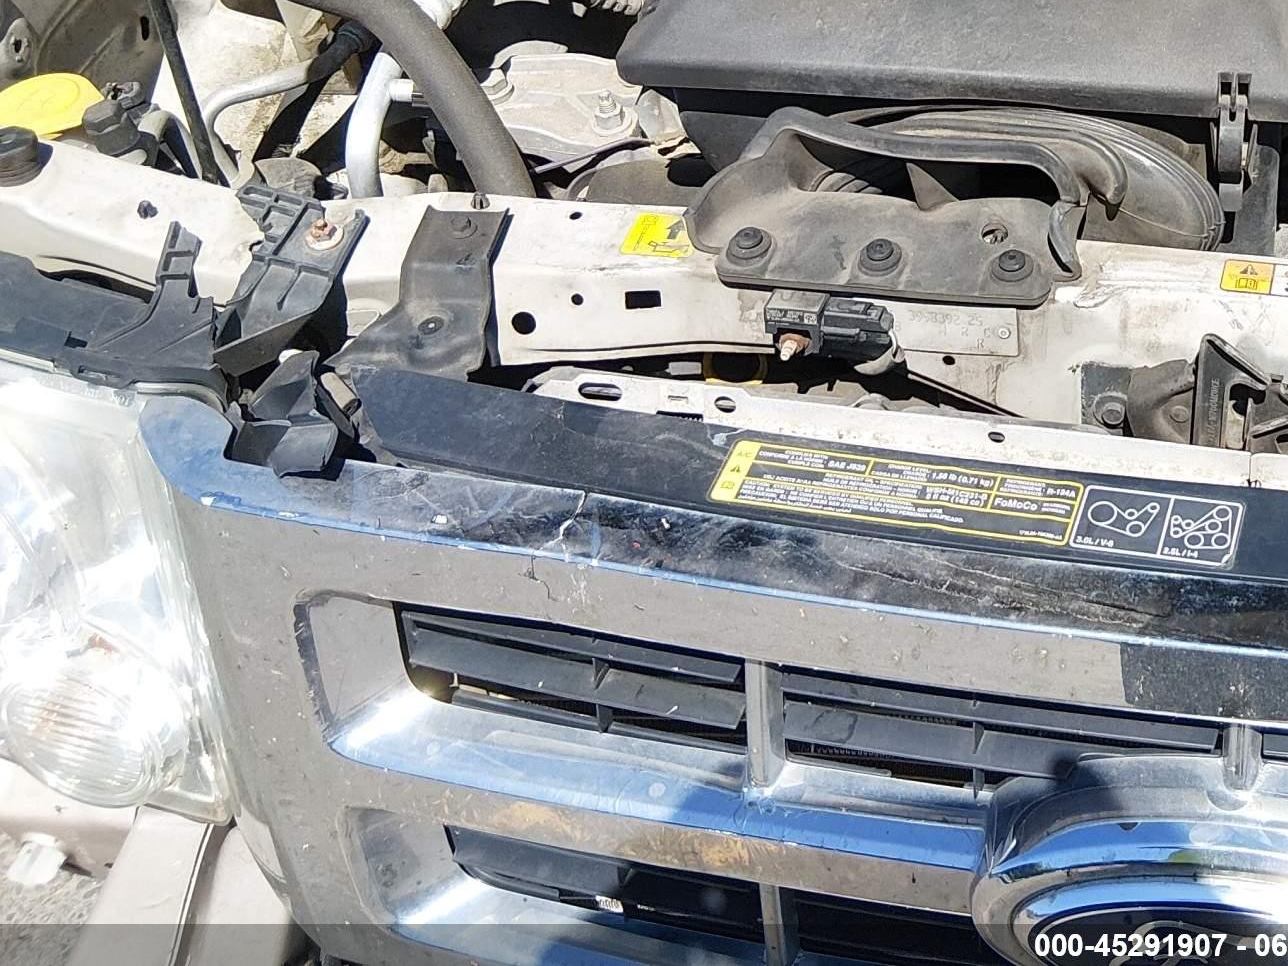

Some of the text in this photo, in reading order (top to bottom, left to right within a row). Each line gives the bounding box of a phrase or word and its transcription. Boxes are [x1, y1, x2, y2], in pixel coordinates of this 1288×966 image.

[828, 461, 847, 470] SAE
[994, 497, 1038, 511] FoMoCo
[1076, 535, 1094, 545] 3.0L
